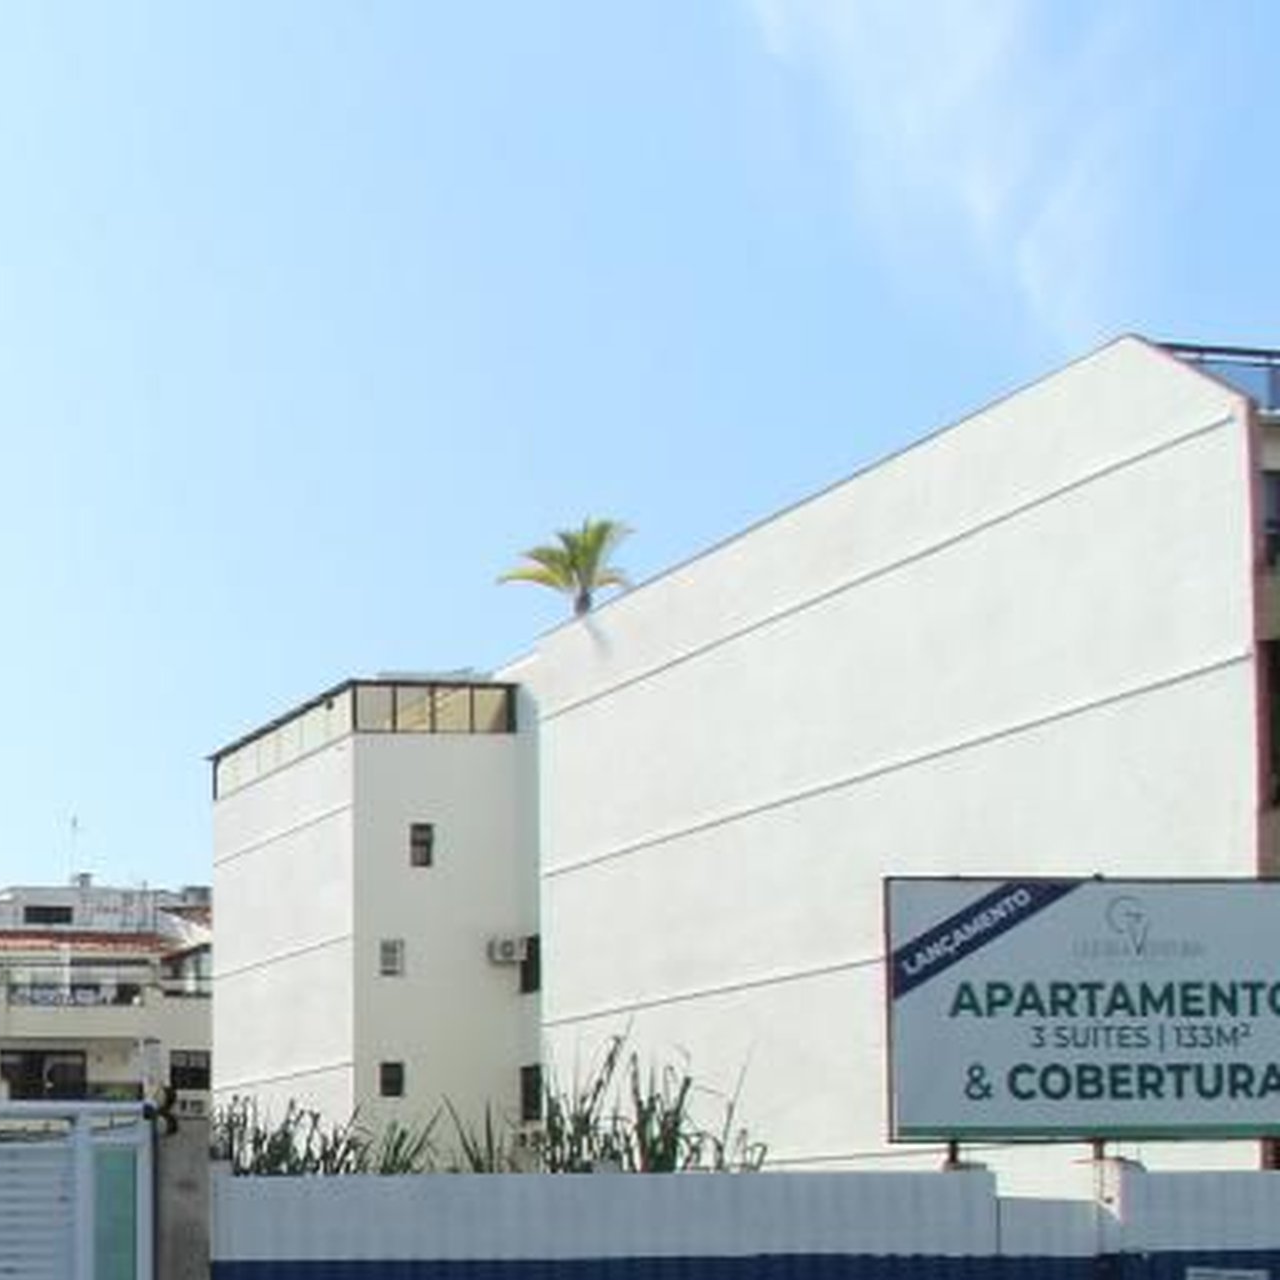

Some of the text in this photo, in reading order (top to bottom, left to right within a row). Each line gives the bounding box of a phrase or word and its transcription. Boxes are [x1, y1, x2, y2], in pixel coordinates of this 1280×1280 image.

[902, 888, 1031, 974] LANÇAMENTO
[1031, 1026, 1045, 1048] 3
[964, 1065, 993, 1100] &
